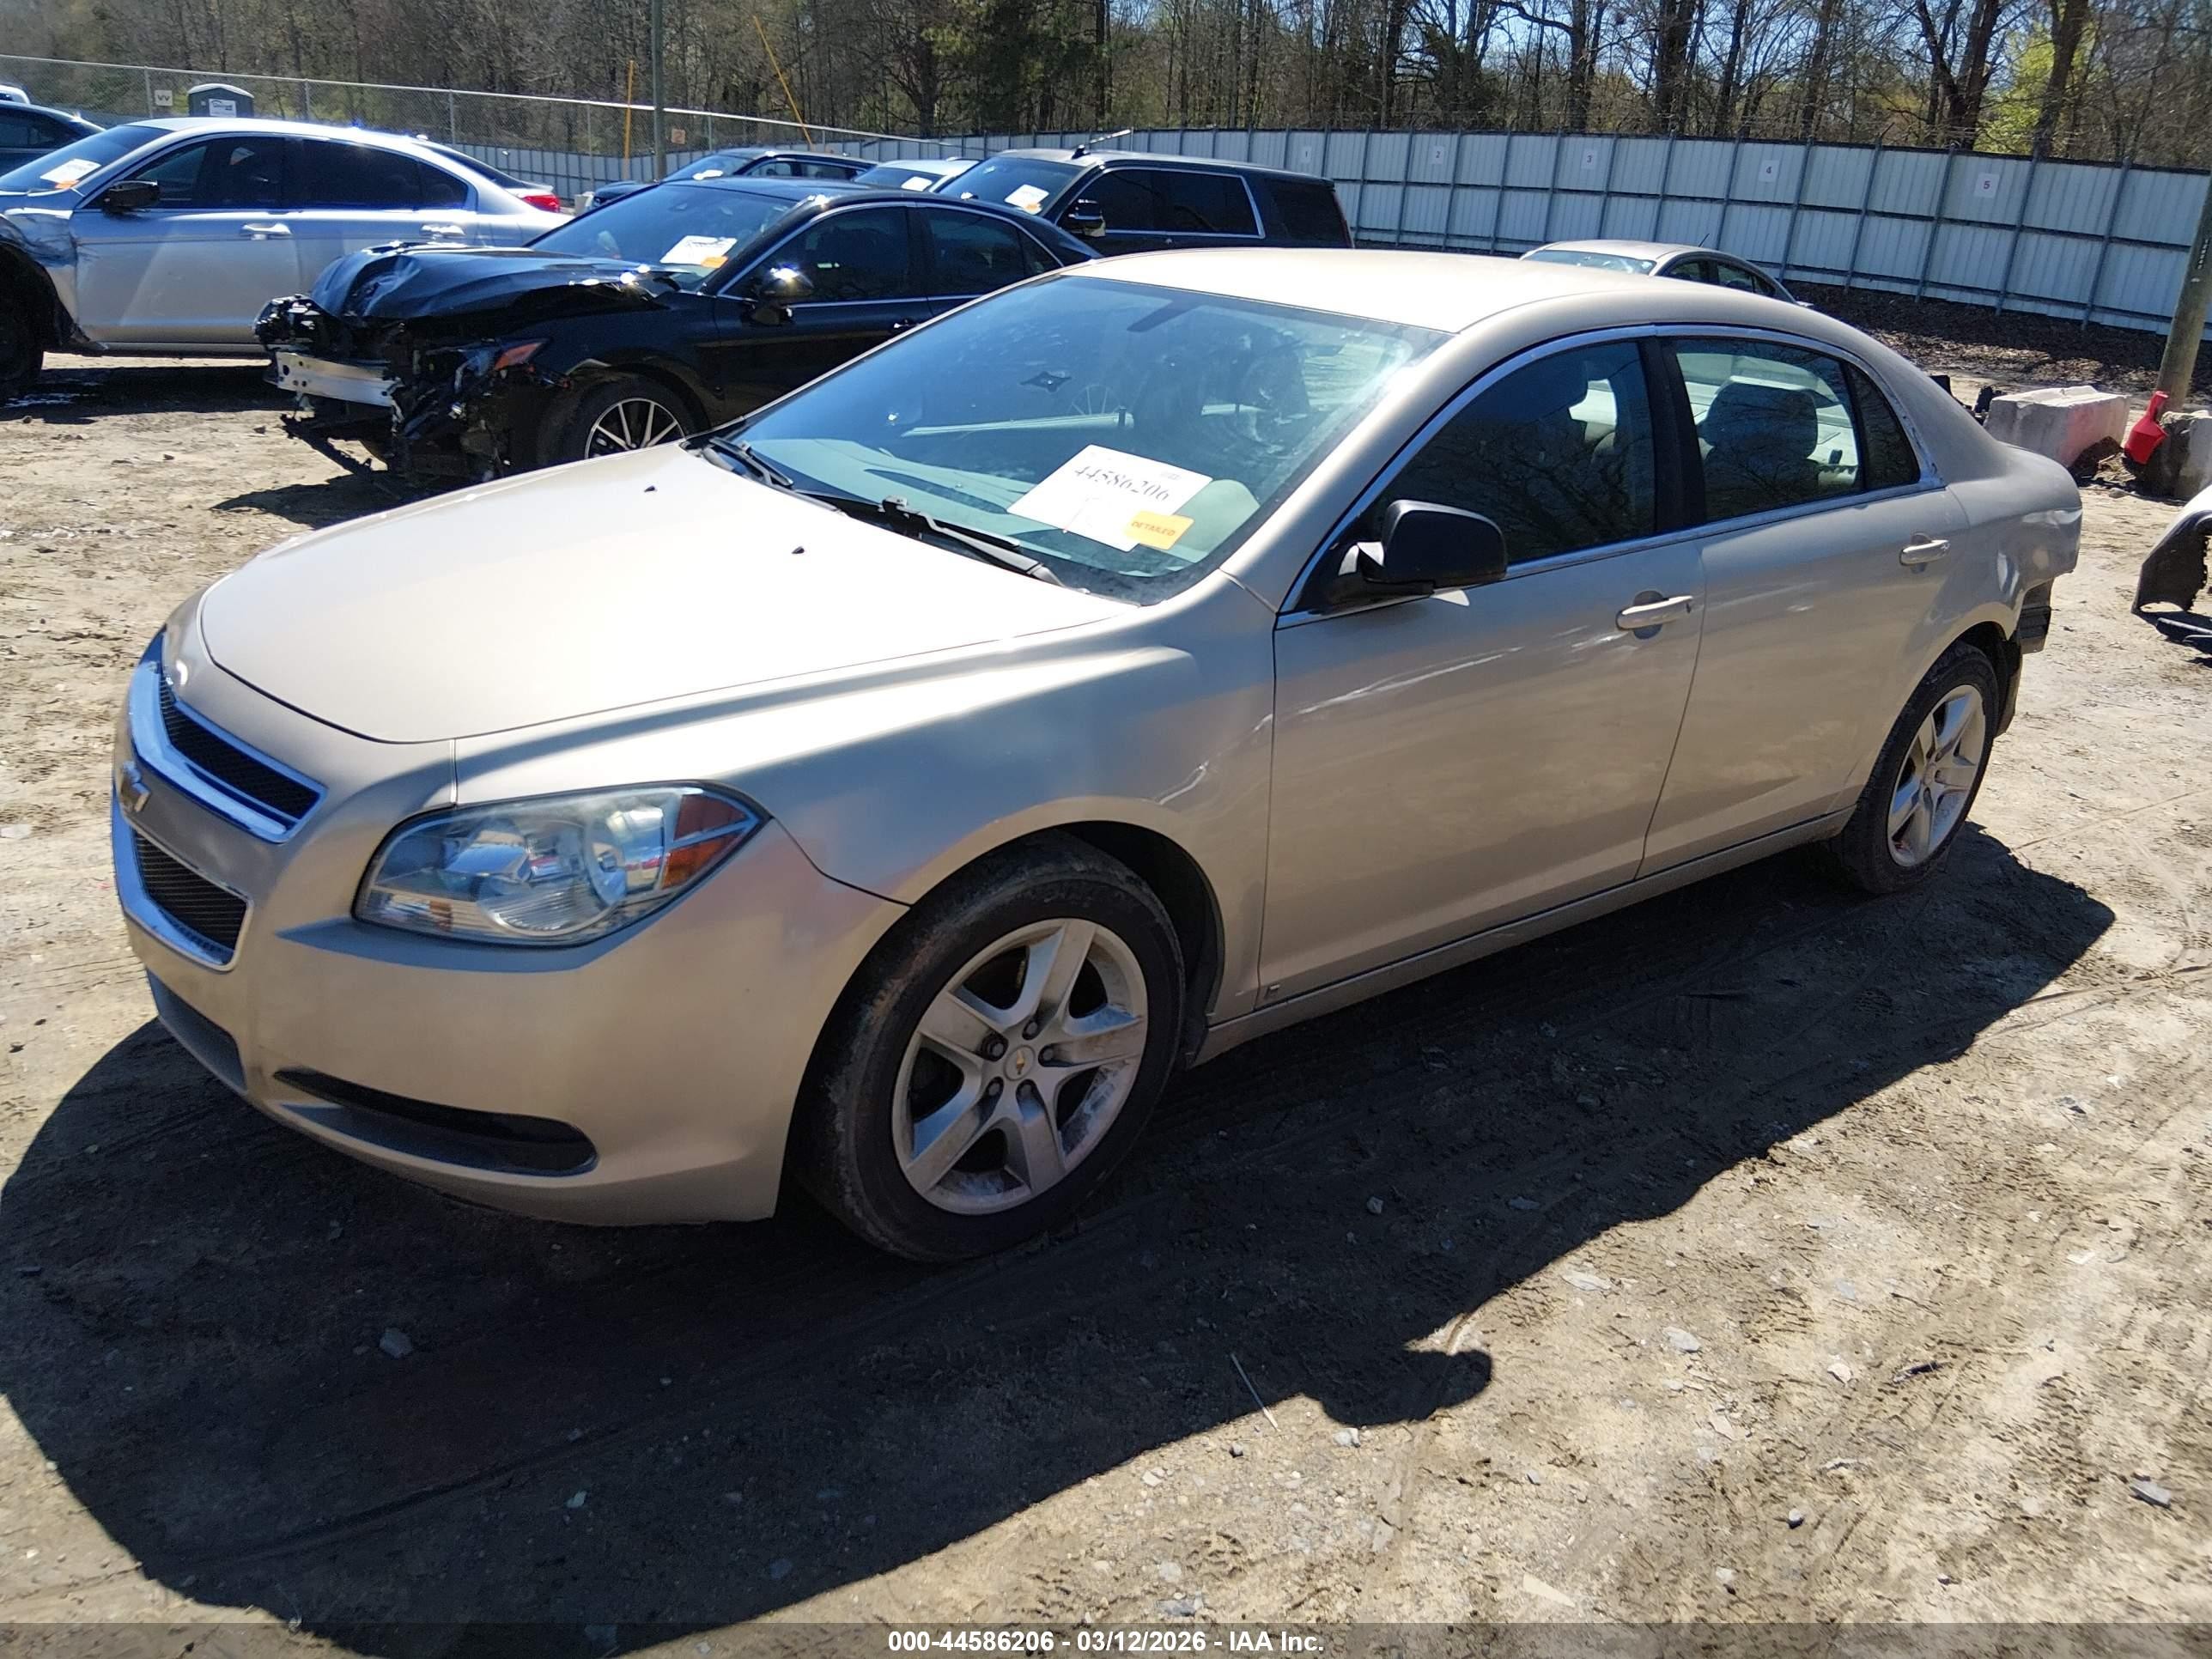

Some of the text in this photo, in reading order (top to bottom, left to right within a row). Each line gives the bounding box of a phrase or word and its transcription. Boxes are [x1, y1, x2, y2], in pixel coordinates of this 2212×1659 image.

[1765, 166, 1772, 174] 4
[1983, 180, 1990, 189] 5
[1074, 466, 1170, 501] 44586206
[1130, 520, 1176, 537] DETAILED
